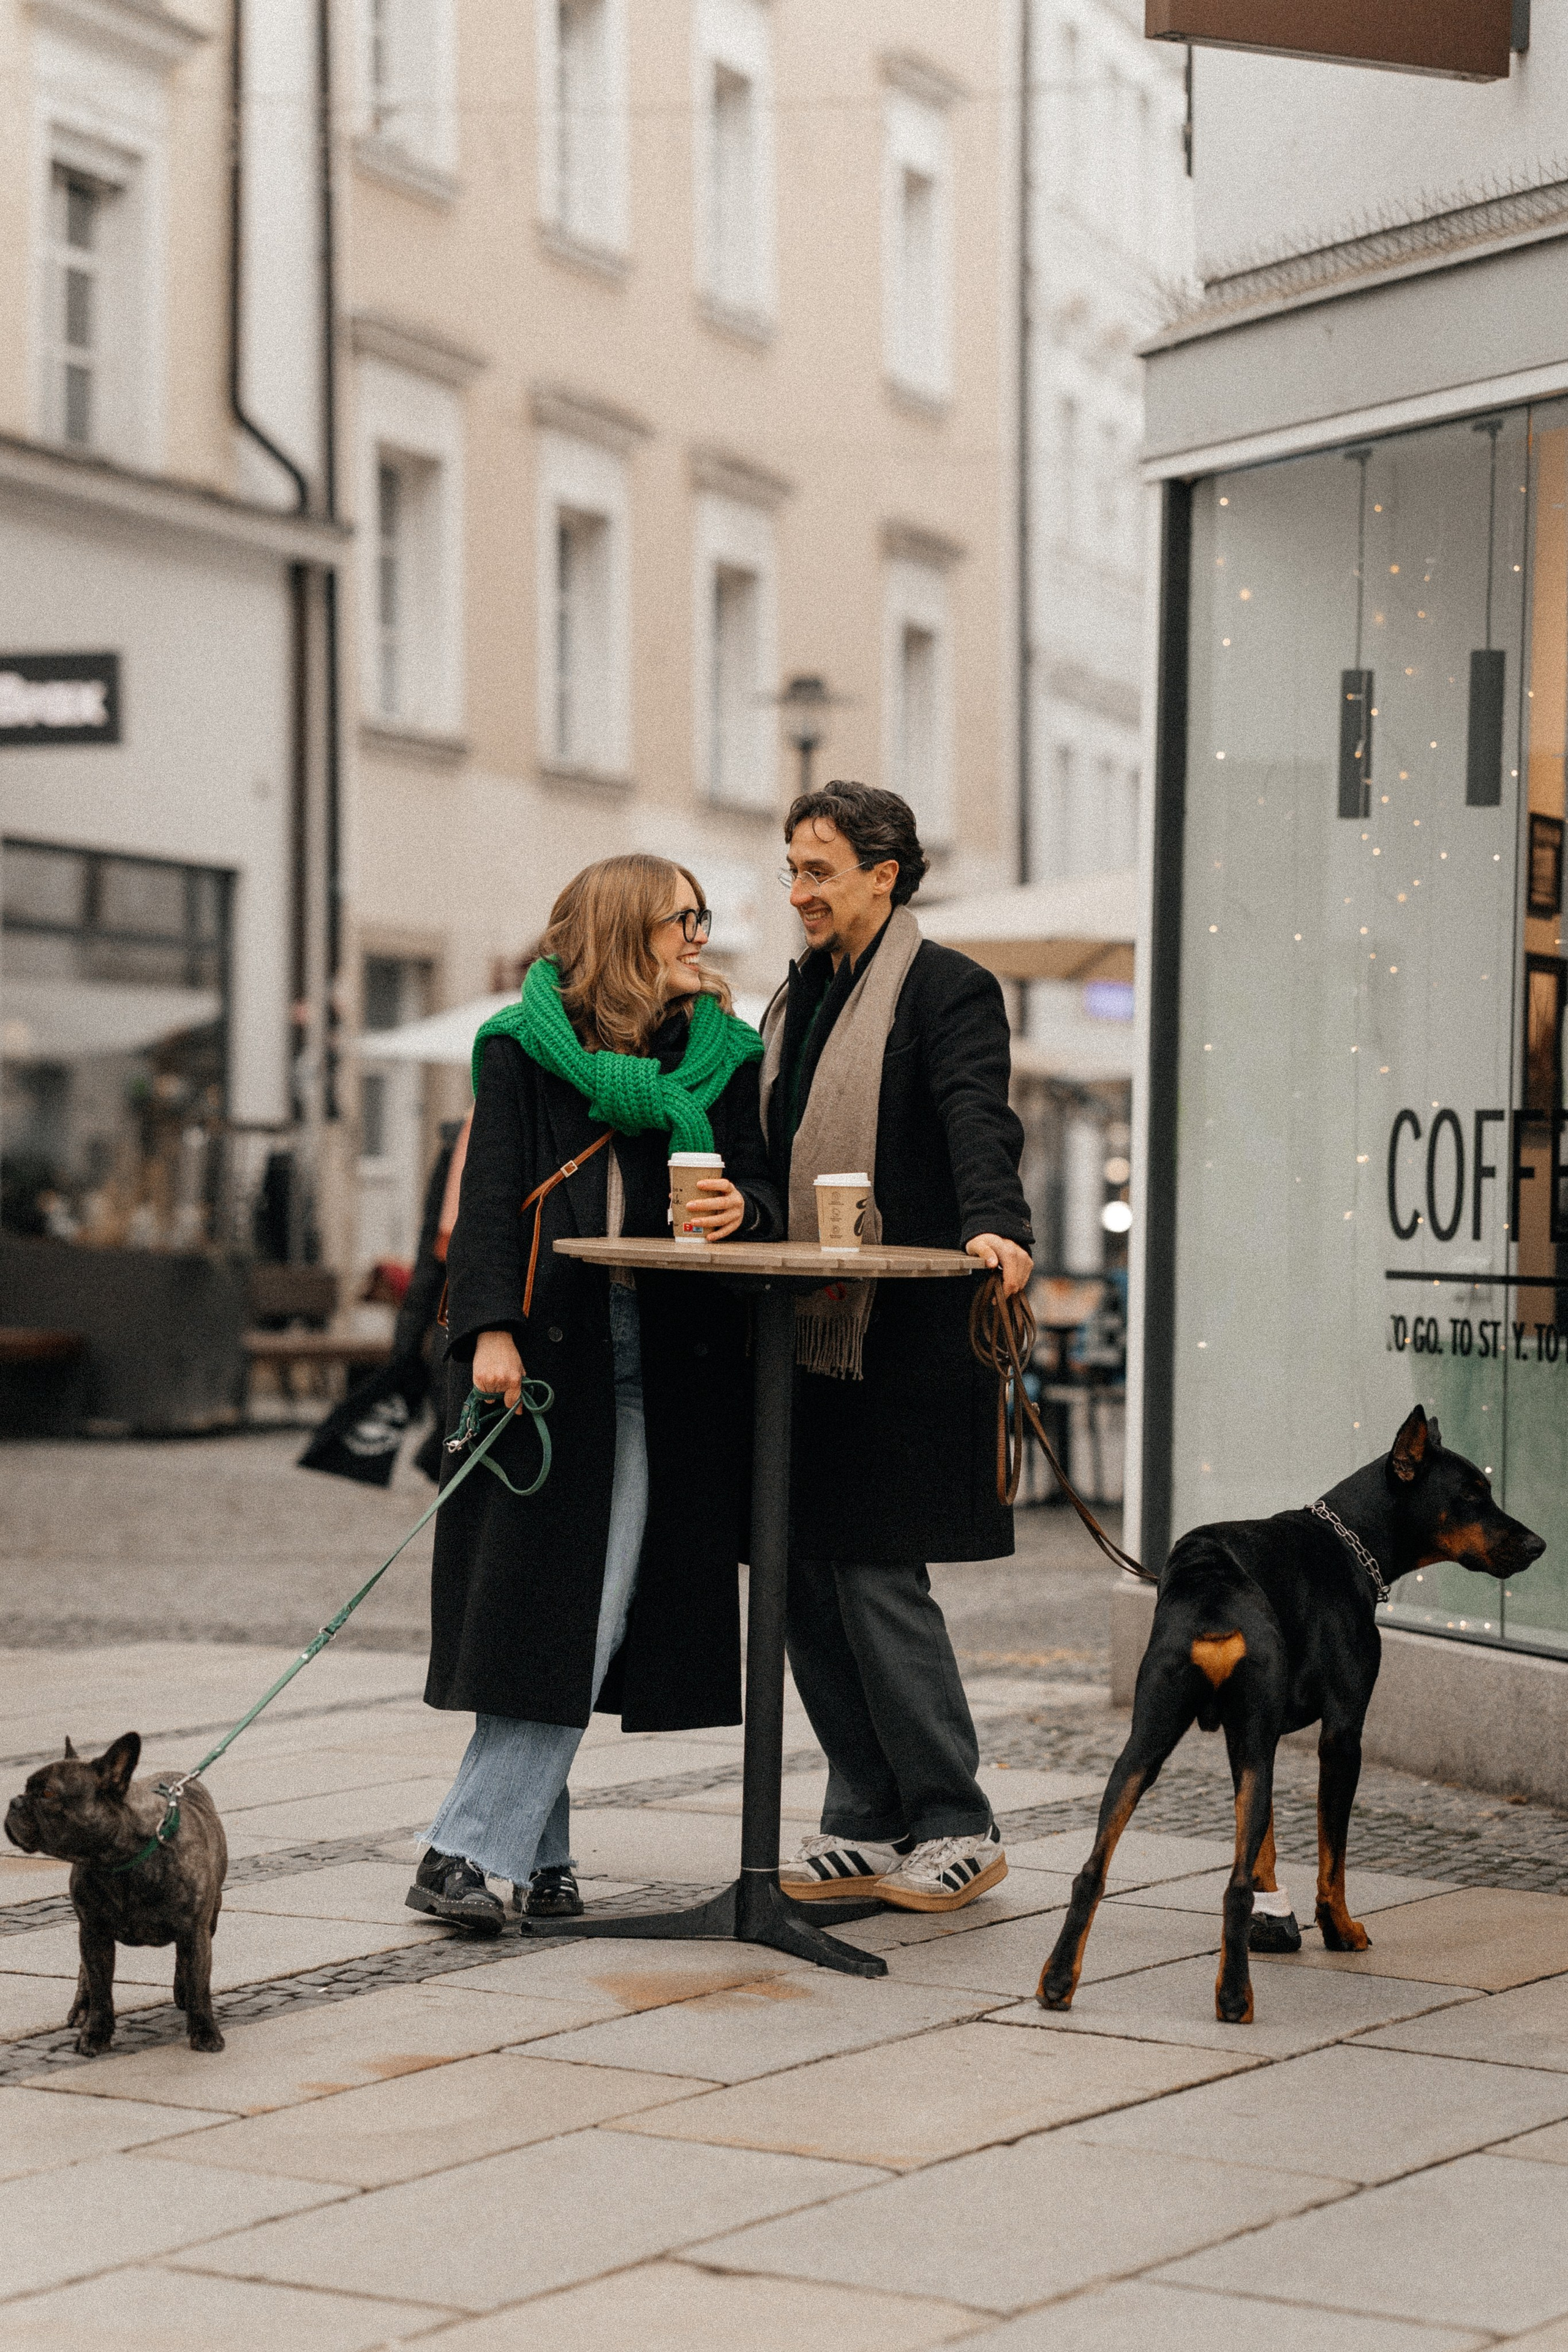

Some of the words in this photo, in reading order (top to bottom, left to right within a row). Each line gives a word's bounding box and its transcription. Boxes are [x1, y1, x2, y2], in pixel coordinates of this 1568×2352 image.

[1413, 1316, 1442, 1354] GO.
[1450, 1318, 1472, 1357] TO
[1534, 1322, 1559, 1363] TO
